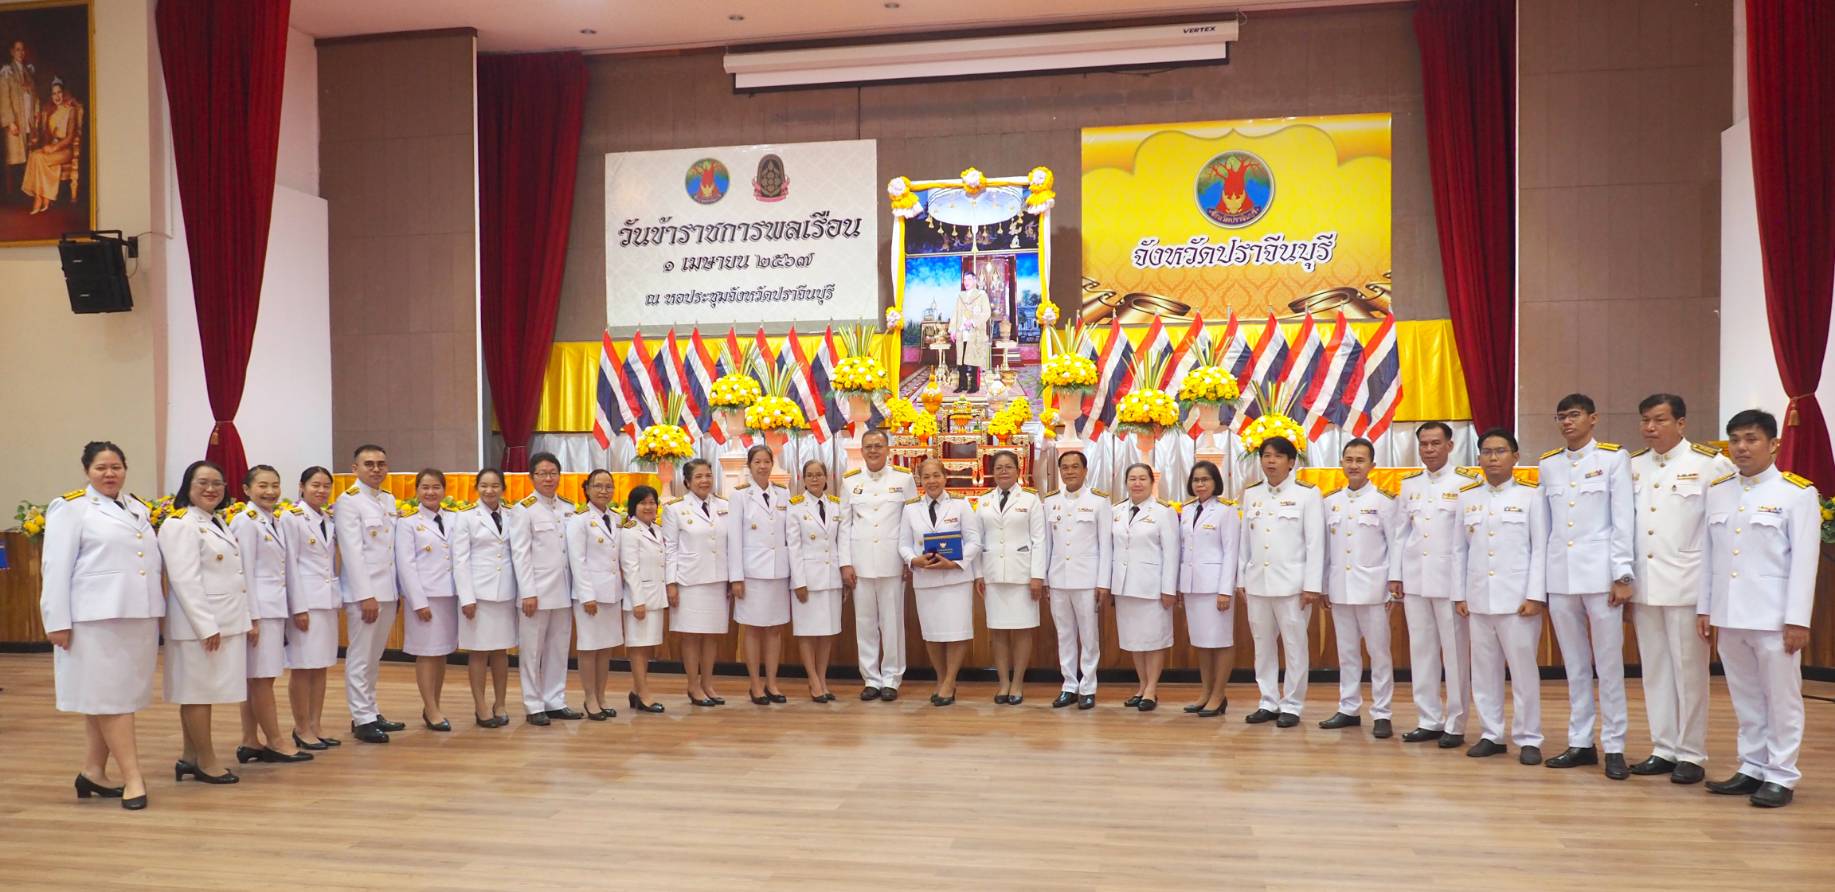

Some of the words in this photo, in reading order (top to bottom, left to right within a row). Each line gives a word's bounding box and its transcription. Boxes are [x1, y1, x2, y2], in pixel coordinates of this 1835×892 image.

[1183, 26, 1216, 34] VERTEX
[617, 211, 863, 248] วันข้าราชการพลเรือน
[663, 260, 675, 272] ๑
[681, 254, 750, 271] เมษายน
[755, 252, 816, 268] ๒๕๖๗
[1133, 234, 1336, 270] จังหวัดปราจีนบุรี
[645, 292, 660, 306] ณ
[664, 283, 835, 308] หอประชุมจังหวัดปราจีนบุรี
